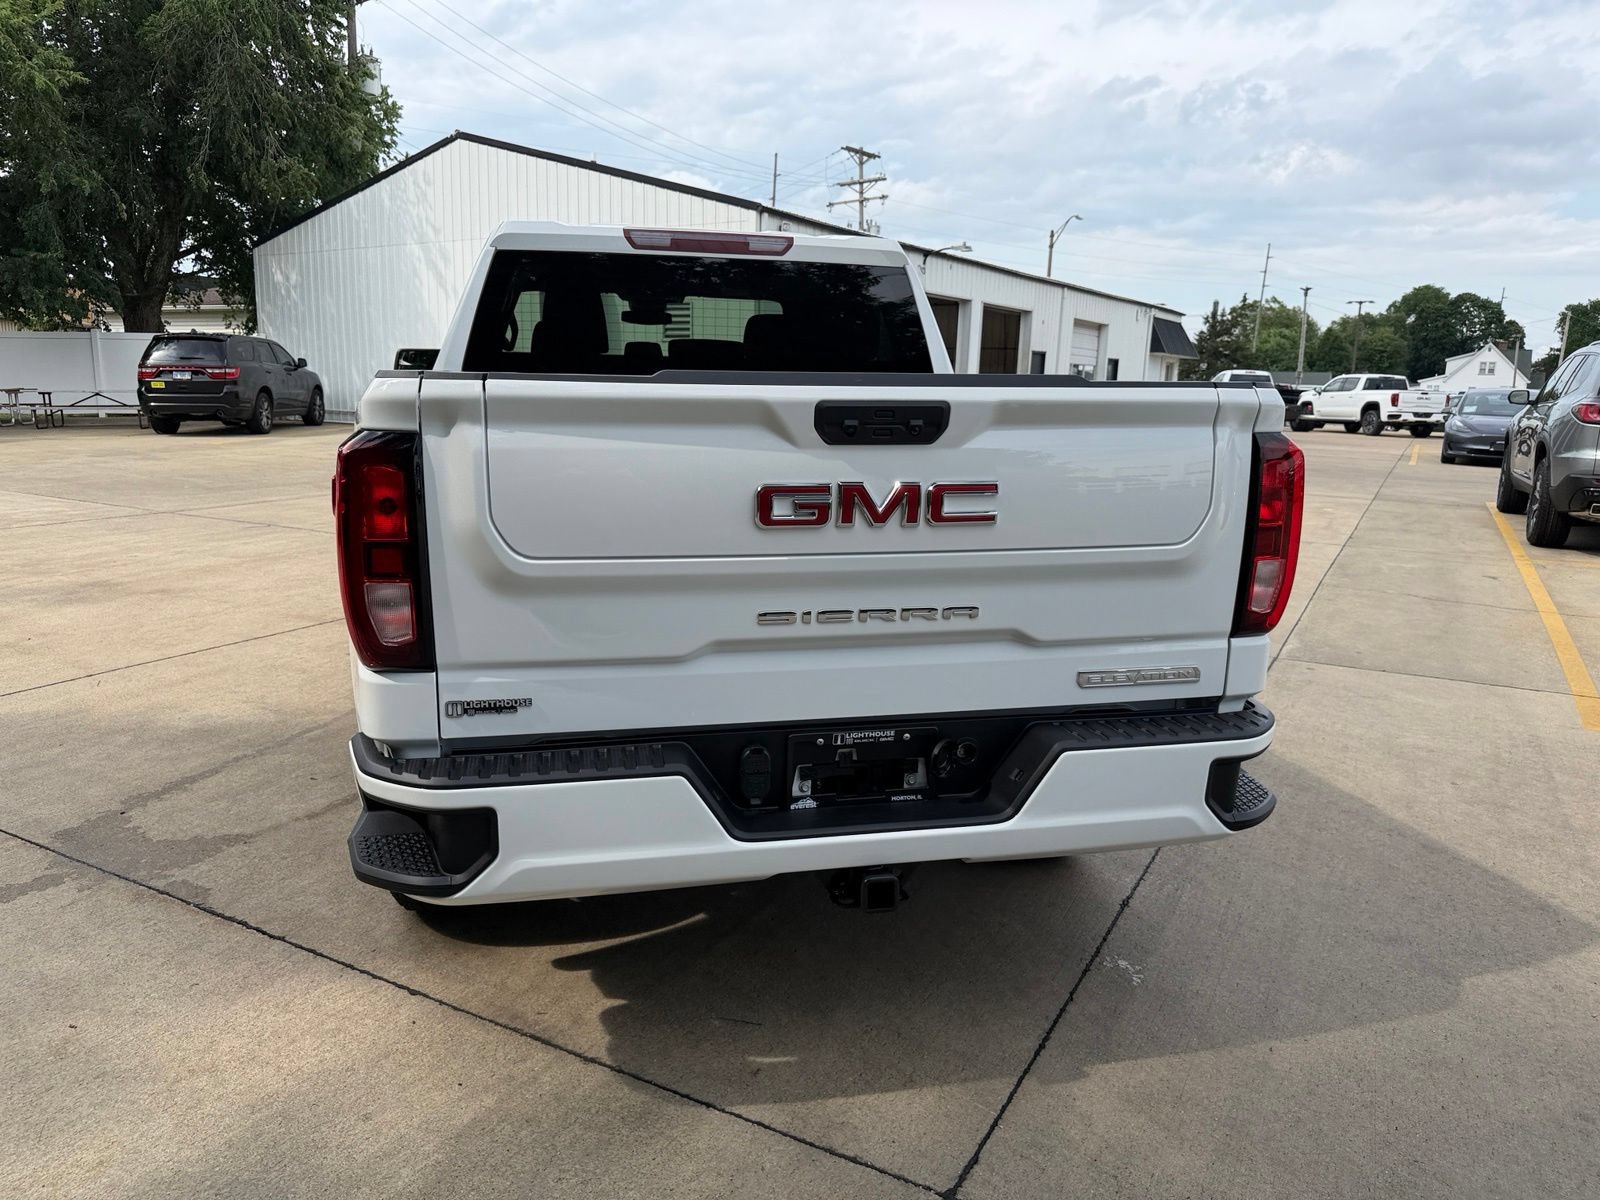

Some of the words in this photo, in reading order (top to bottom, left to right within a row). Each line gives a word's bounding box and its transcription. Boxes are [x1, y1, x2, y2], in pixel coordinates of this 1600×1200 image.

[754, 481, 999, 528] GMC
[757, 606, 980, 625] SIERRA
[1087, 669, 1192, 684] ELEVATION
[464, 698, 532, 709] LIGHTHOUSE
[846, 730, 895, 739] LIGHTHOUSE
